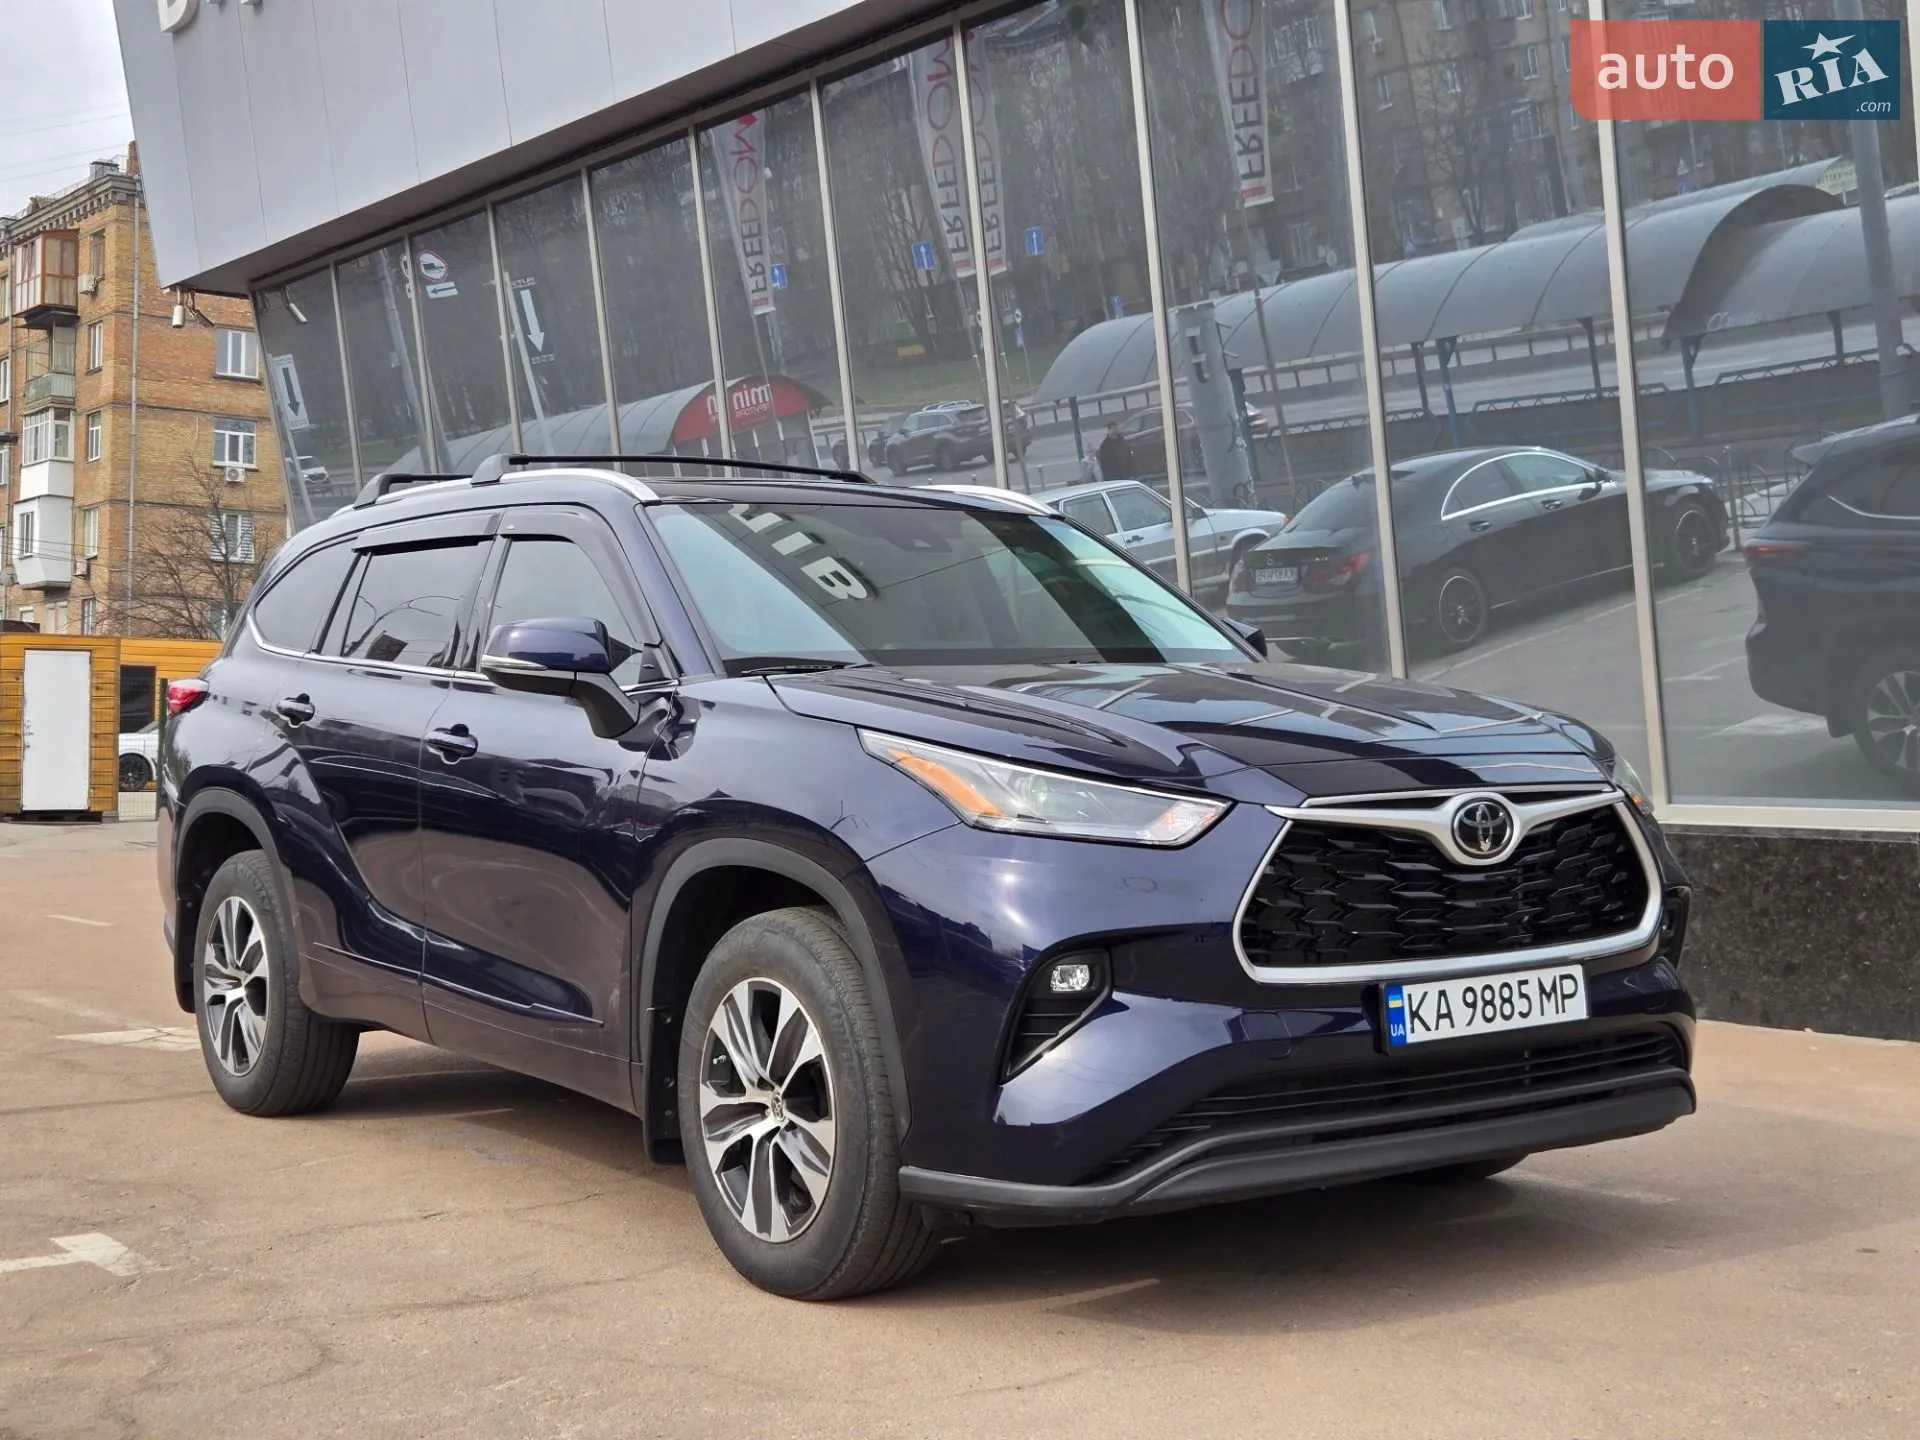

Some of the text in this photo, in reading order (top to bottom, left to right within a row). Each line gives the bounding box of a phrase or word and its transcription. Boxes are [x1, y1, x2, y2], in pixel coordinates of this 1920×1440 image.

[1407, 973, 1579, 1034] KA 9885 MP
[1390, 1023, 1405, 1037] UA
